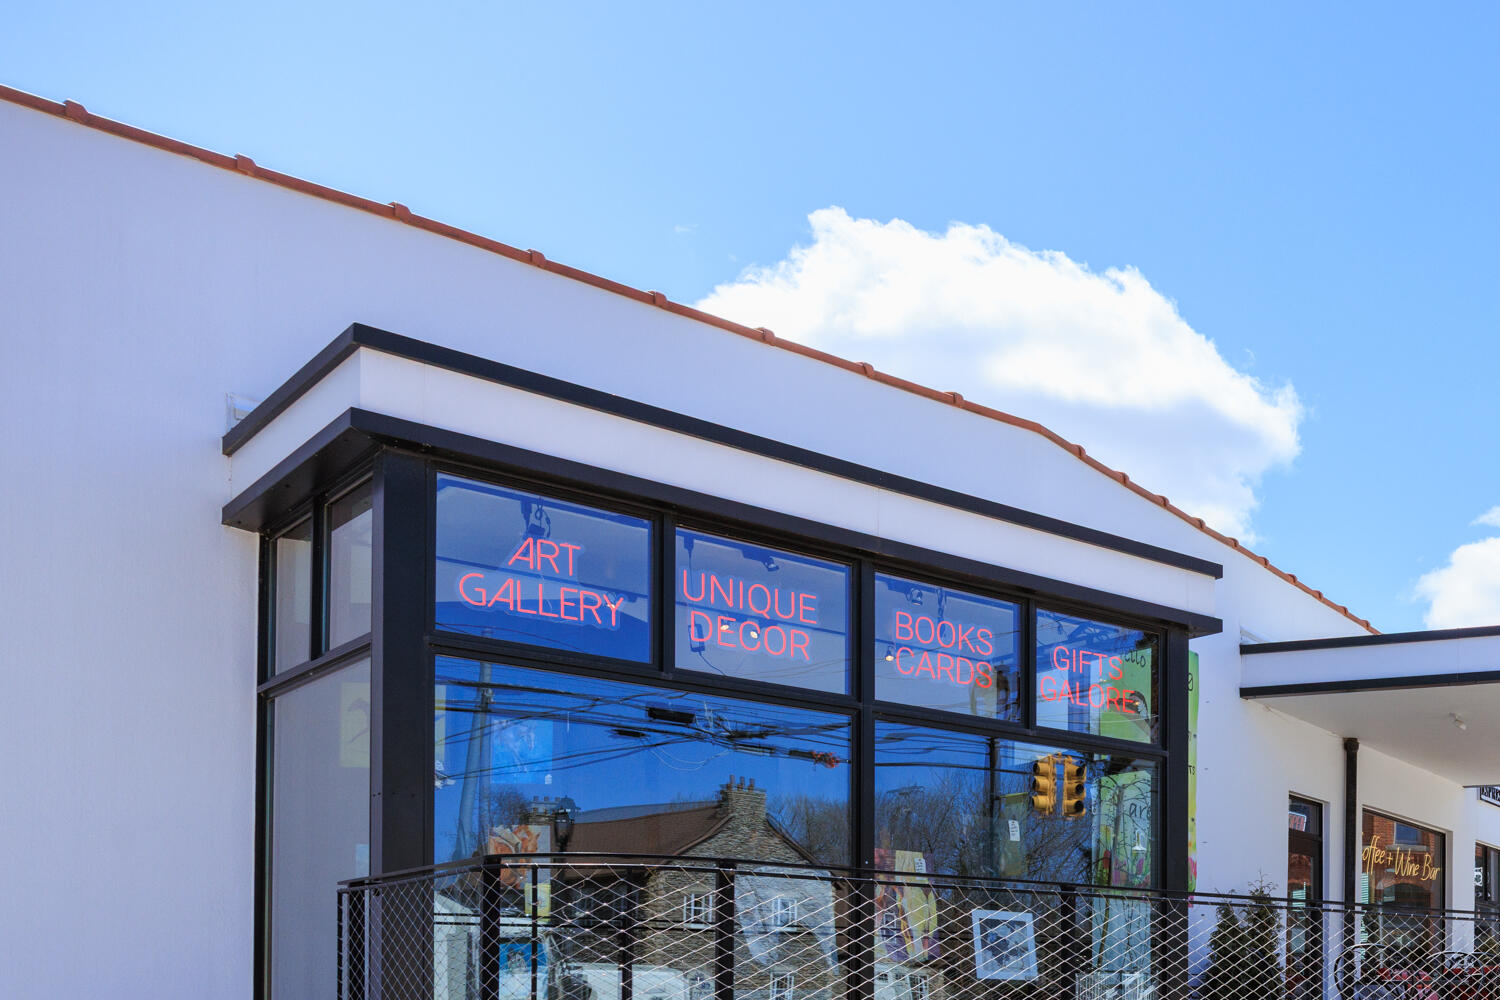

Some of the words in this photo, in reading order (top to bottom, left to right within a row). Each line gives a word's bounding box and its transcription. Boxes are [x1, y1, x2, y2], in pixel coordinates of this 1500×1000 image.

[508, 536, 582, 577] ART
[459, 572, 625, 627] GALLERY
[682, 569, 819, 624] UNIQUE
[690, 611, 812, 661] DECOR
[894, 610, 994, 656] BOOKS
[895, 645, 994, 689] CARDS
[1052, 645, 1125, 681] GIFTS
[1039, 675, 1138, 714] GALORE
[1361, 833, 1386, 876] offee
[1394, 846, 1420, 877] Wine
[1420, 852, 1441, 881] Bar
